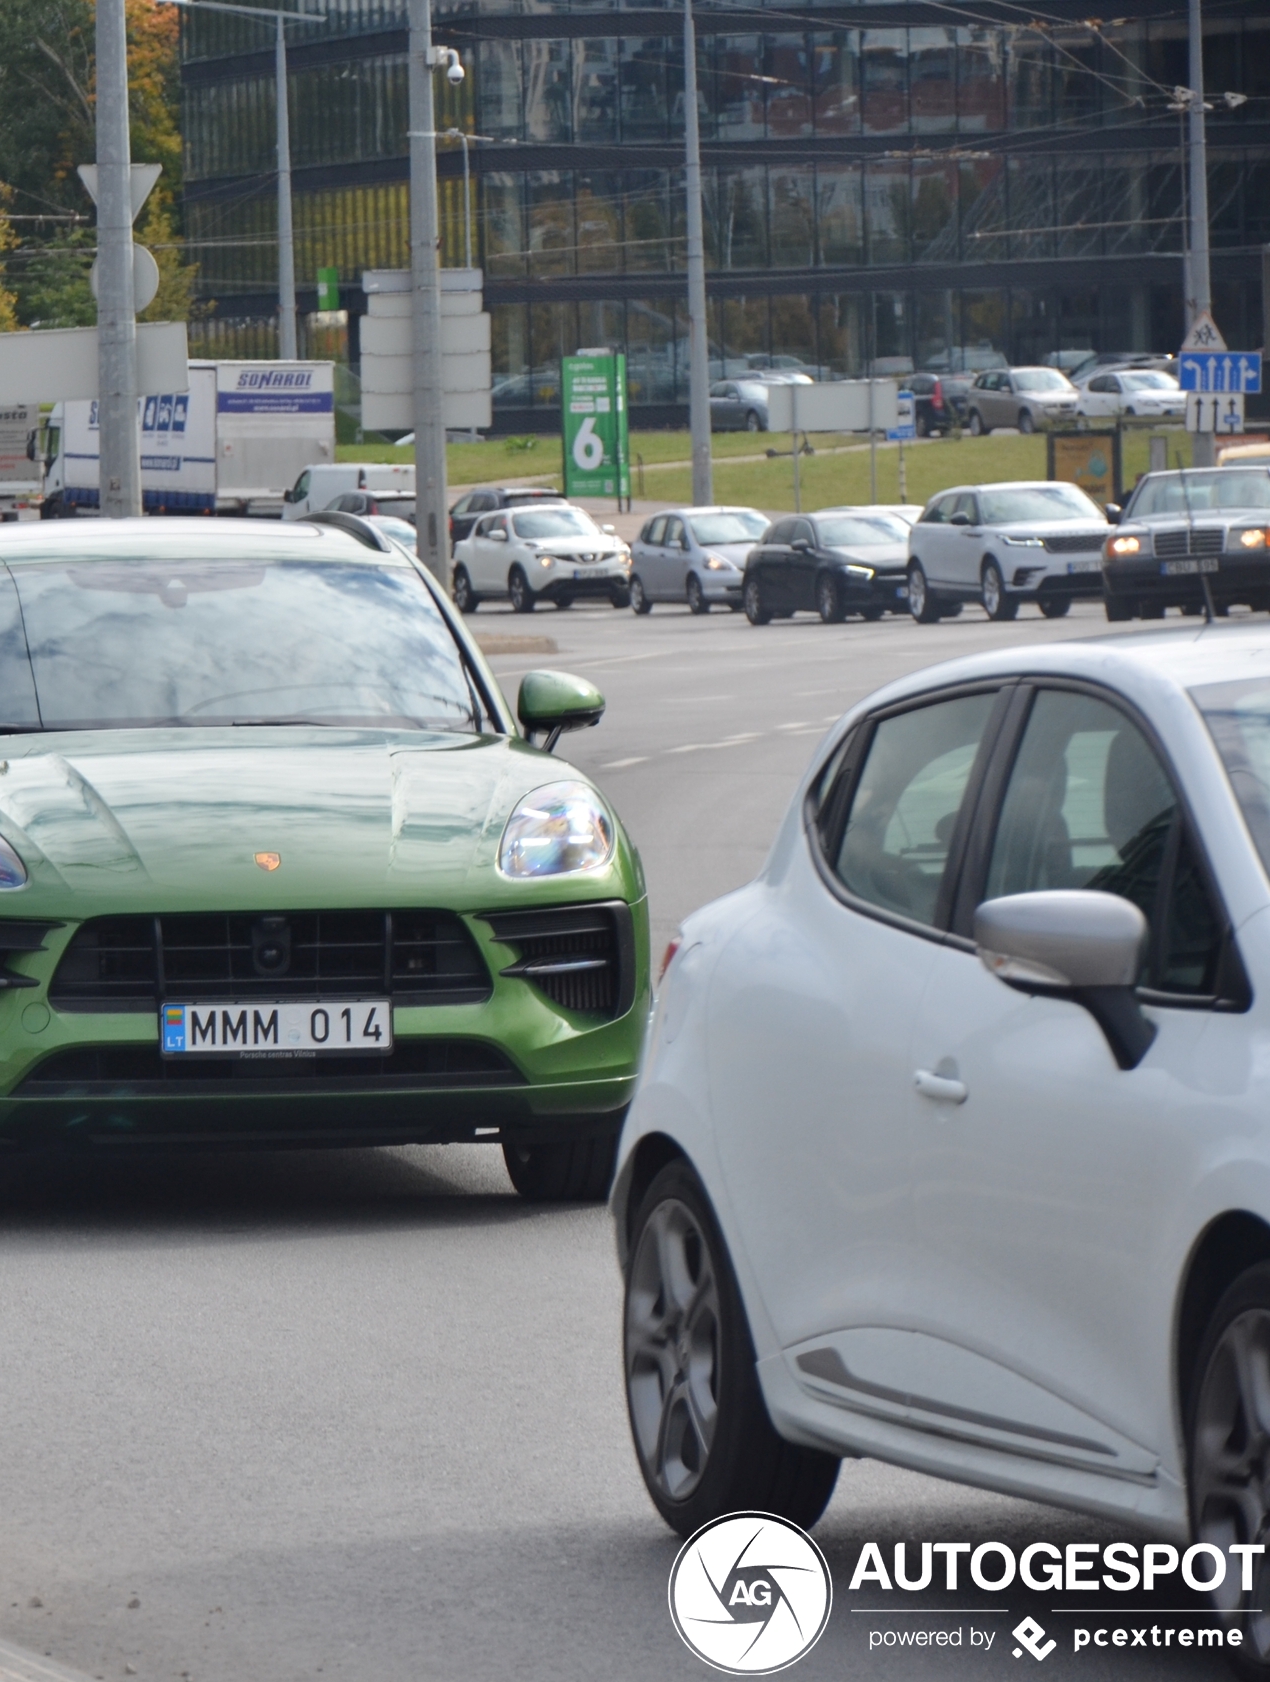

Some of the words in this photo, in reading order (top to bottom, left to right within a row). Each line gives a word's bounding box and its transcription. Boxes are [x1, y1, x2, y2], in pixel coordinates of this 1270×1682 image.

[573, 417, 604, 470] 6
[190, 1010, 278, 1046] MMM
[310, 1007, 382, 1043] 014
[167, 1036, 184, 1047] LT
[240, 1051, 266, 1059] Porsche
[294, 1050, 316, 1058] Vilnius
